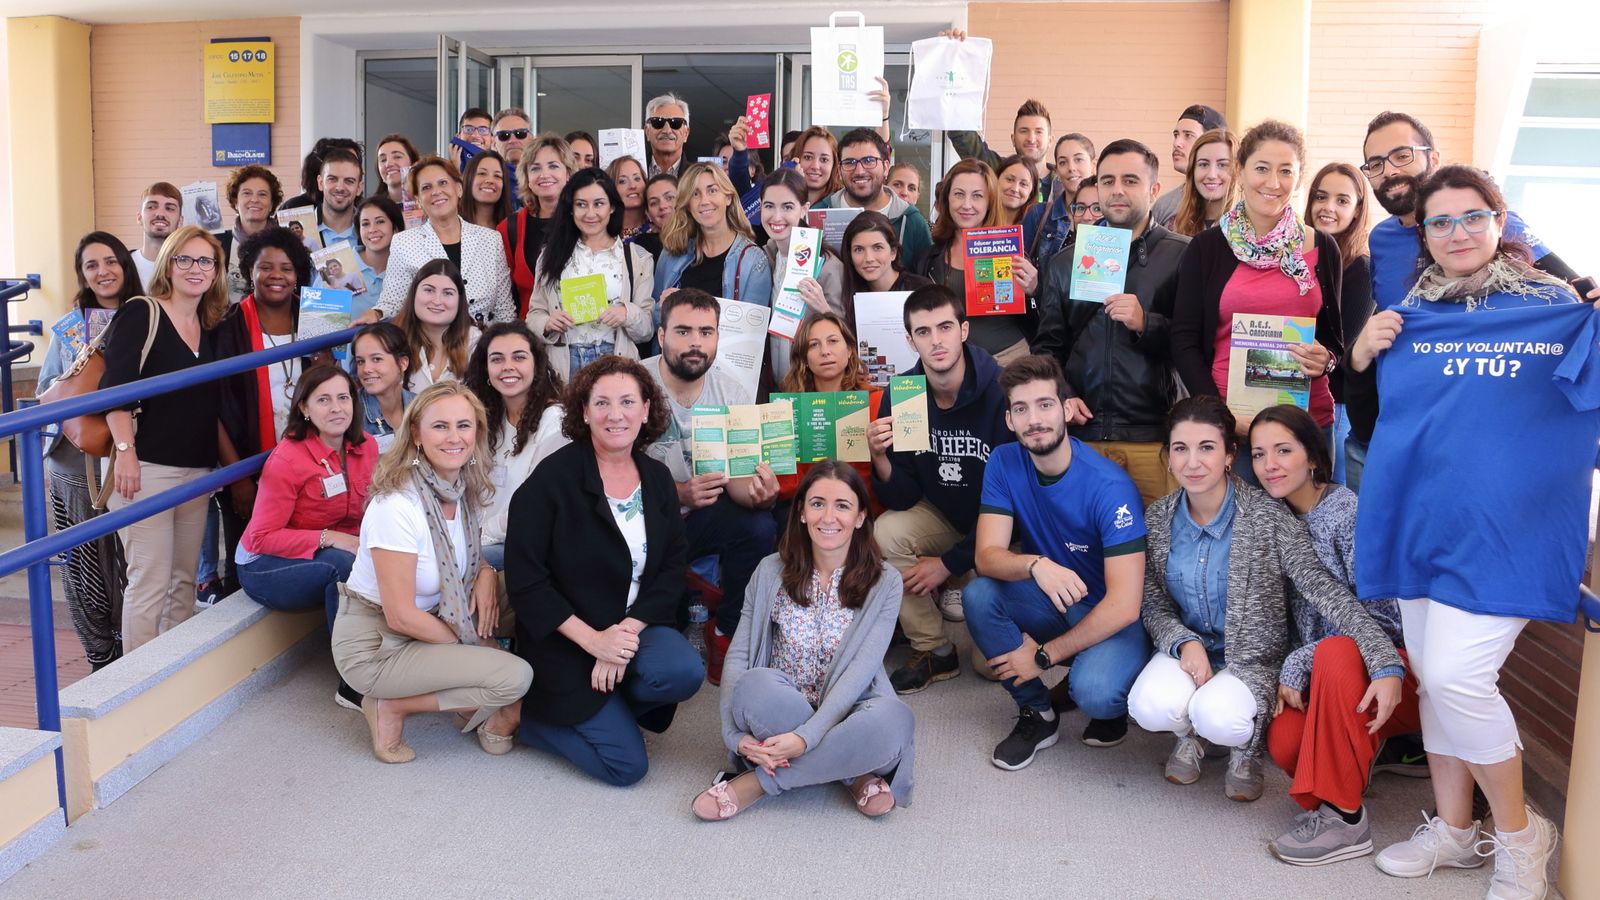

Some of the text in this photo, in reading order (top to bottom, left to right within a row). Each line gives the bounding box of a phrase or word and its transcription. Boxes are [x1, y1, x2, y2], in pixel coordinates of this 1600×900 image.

[969, 245, 1017, 254] TOLERANCIA
[1250, 320, 1271, 329] A.E.S.
[1249, 329, 1282, 338] CANDELARIA
[1412, 342, 1564, 355] YO SOY VOLUNTARI@
[1443, 355, 1521, 378] ¿Y TÚ?
